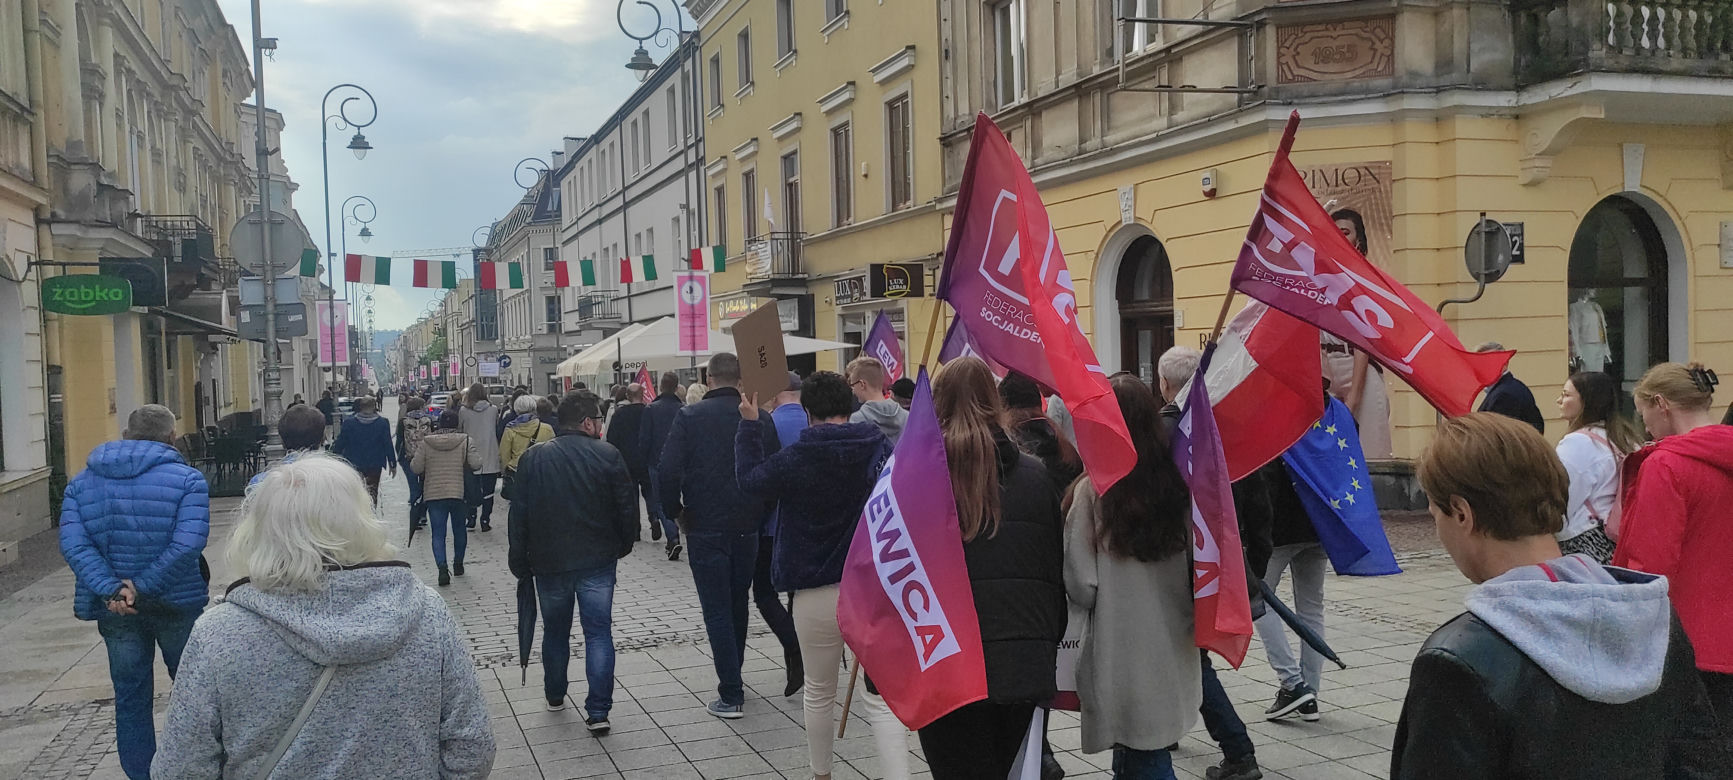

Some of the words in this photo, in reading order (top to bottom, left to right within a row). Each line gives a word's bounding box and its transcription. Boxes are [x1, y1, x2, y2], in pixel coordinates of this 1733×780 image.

[1248, 262, 1323, 290] FEDERAC
[52, 284, 123, 301] żabka
[834, 280, 851, 297] LUX
[984, 290, 1038, 328] FEDERAC
[624, 360, 648, 371] pepi
